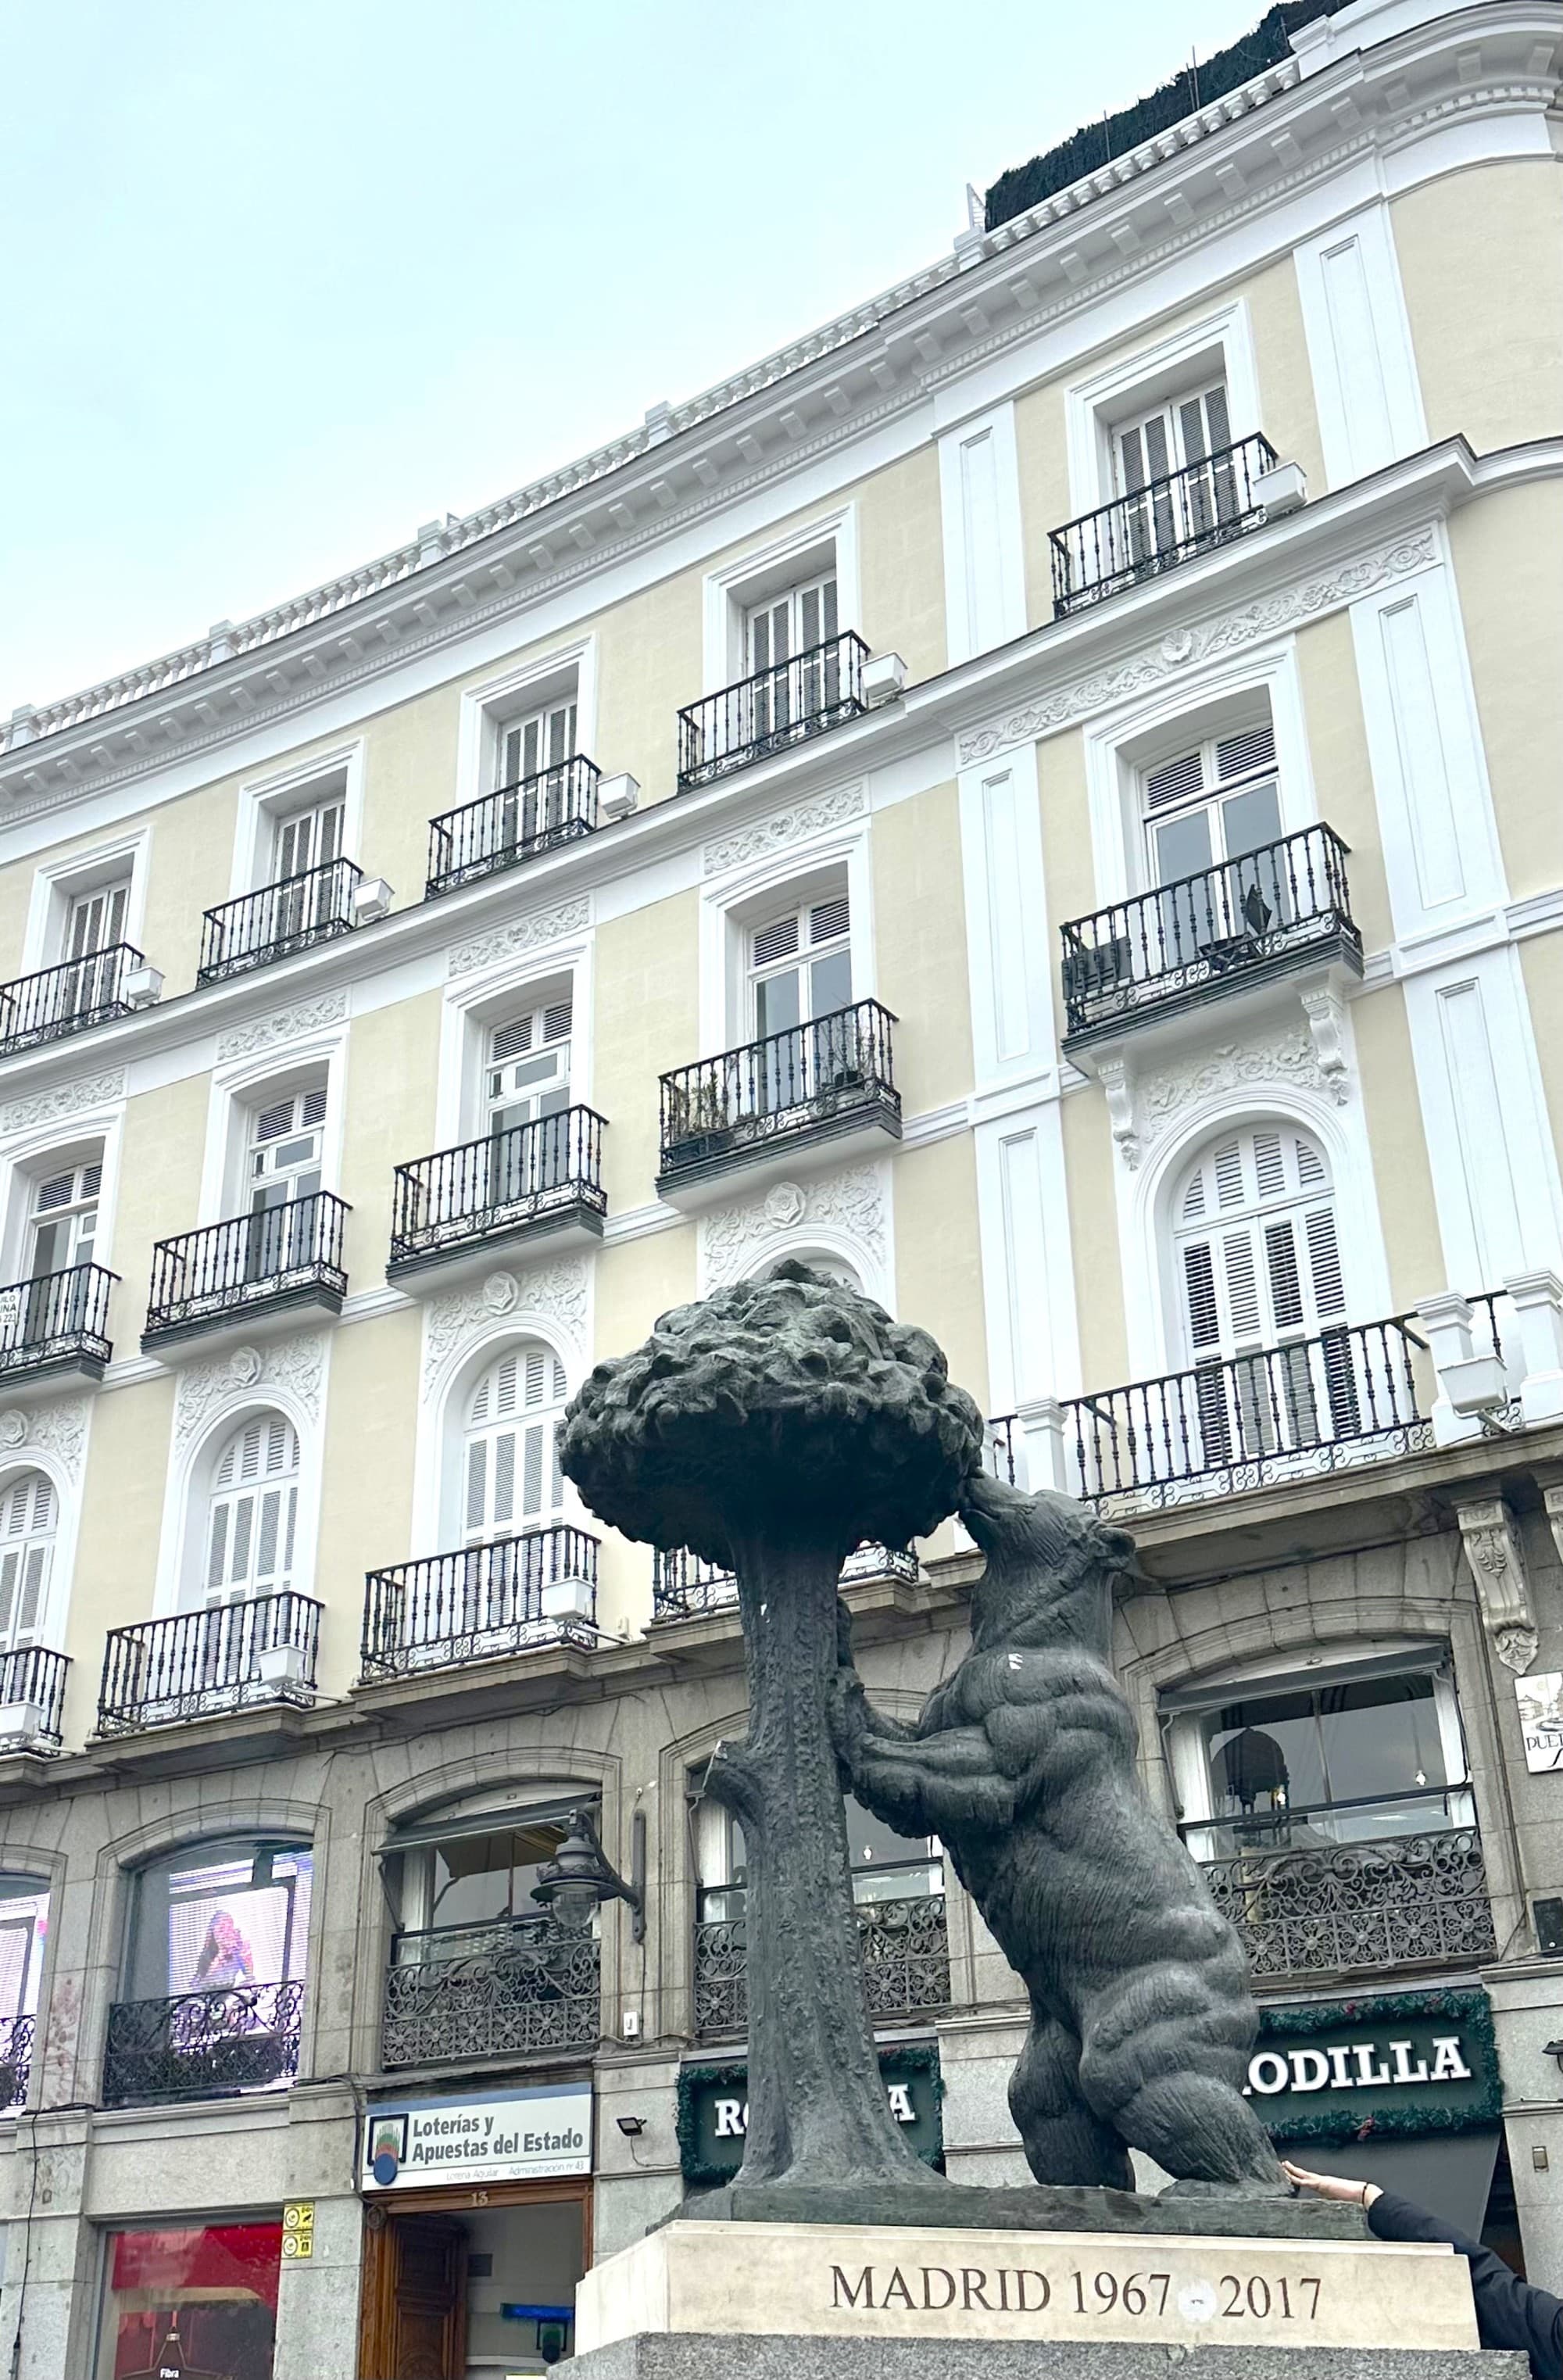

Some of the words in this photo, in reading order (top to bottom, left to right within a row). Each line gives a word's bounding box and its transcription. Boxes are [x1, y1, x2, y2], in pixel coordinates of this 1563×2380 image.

[1242, 2035, 1472, 2095] ODILLA
[413, 2113, 480, 2138] Loterías
[485, 2116, 495, 2136] y
[412, 2138, 488, 2164] Apuestas
[493, 2132, 519, 2155] del
[523, 2128, 584, 2153] Estado
[470, 2191, 488, 2207] 13
[828, 2265, 1051, 2314] MADRID
[1069, 2271, 1171, 2317] 1967
[1219, 2274, 1322, 2321] 2017
